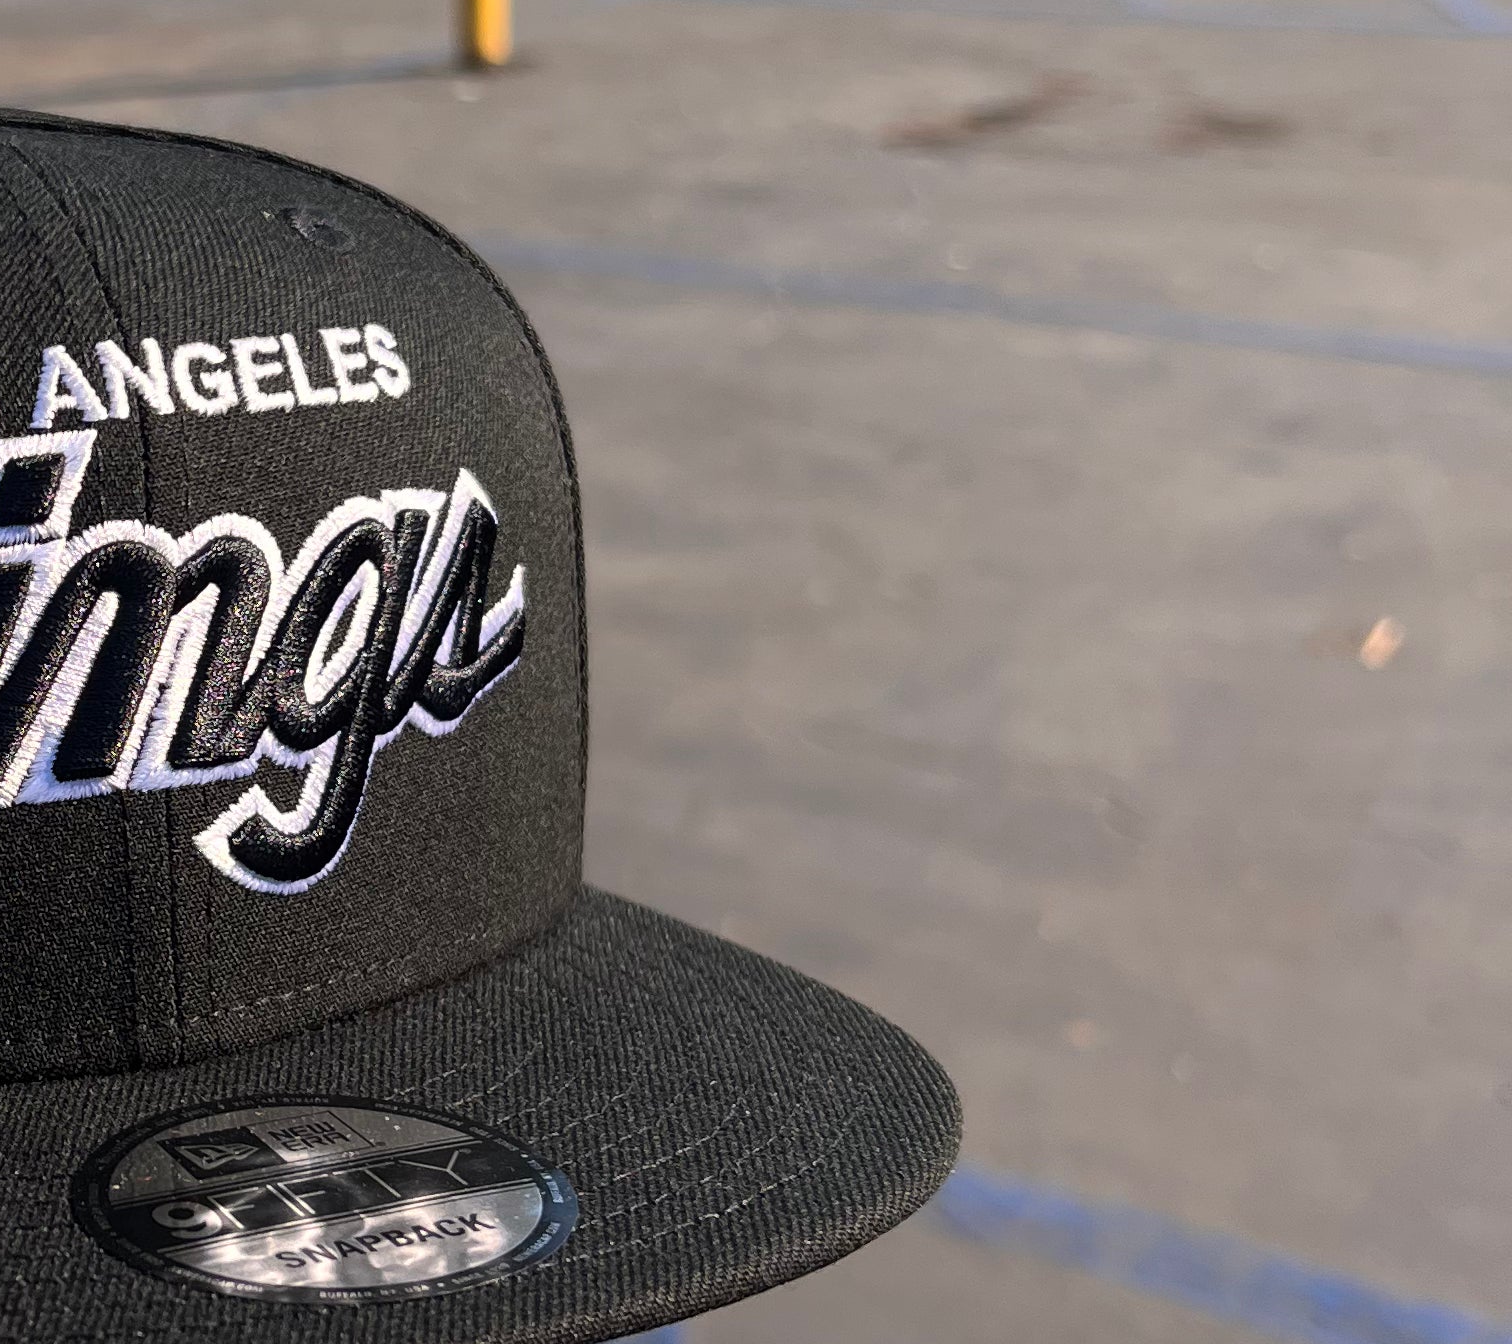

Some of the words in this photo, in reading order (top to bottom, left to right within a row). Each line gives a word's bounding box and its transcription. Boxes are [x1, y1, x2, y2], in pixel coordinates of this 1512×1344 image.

[30, 323, 410, 429] ANGELES
[267, 1121, 336, 1141] NEW
[281, 1131, 349, 1152] ERA
[152, 1149, 468, 1239] 9FIFTY
[275, 1212, 496, 1269] SNAPBACK
